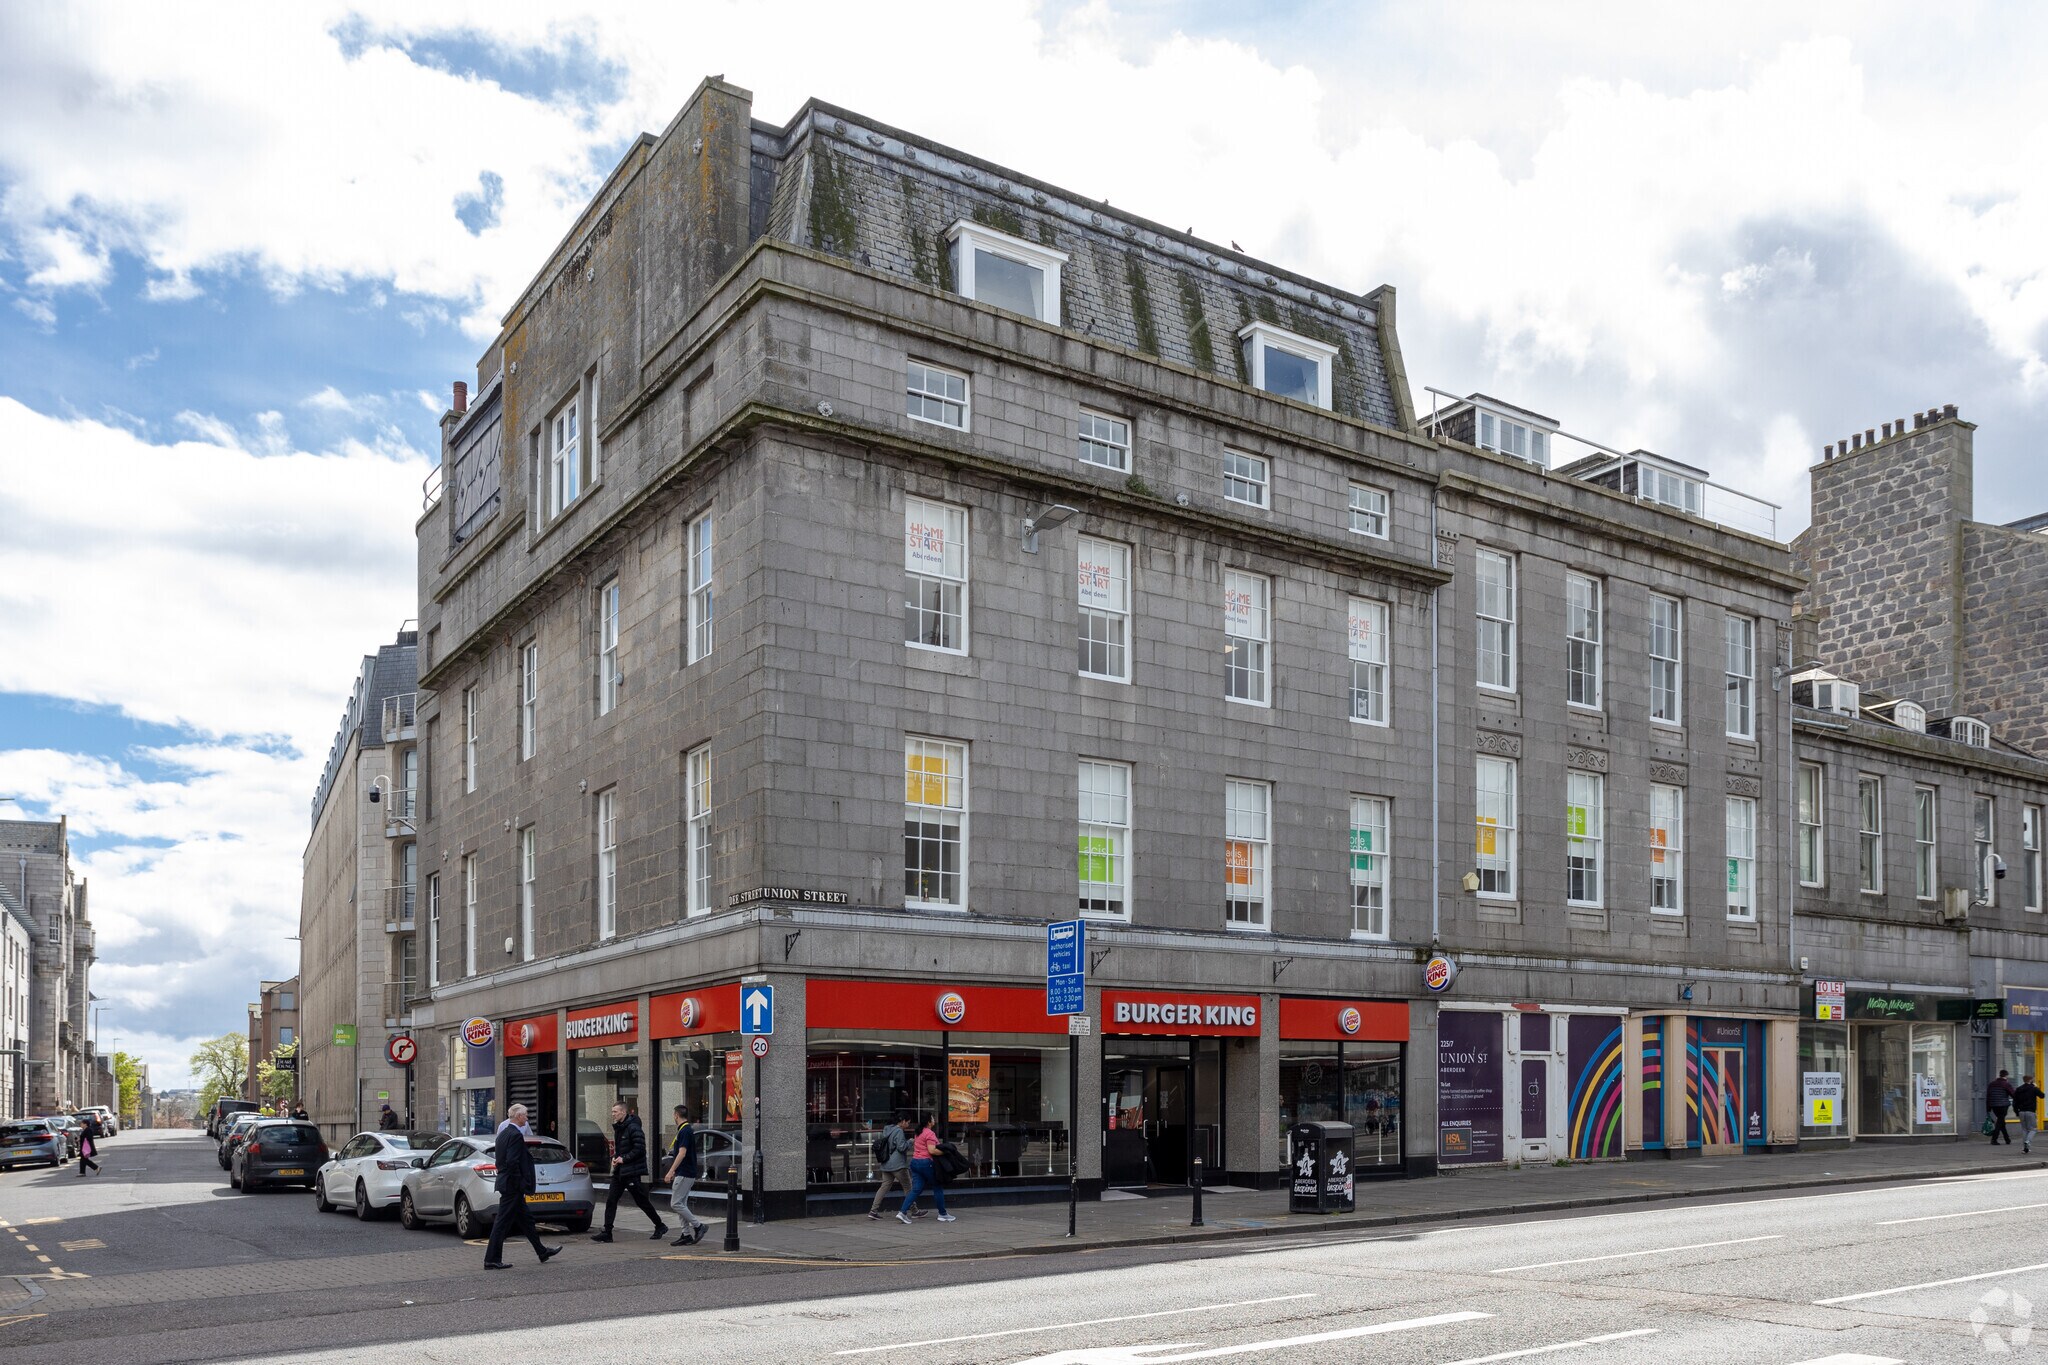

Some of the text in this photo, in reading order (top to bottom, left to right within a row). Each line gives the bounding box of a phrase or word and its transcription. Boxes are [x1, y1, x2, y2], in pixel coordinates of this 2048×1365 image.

[910, 535, 944, 553] START
[912, 552, 942, 563] Aberdeen
[728, 888, 762, 906] DEE STREET
[764, 888, 848, 903] UNION STREET
[1050, 942, 1074, 951] authorised
[1426, 962, 1447, 975] BURGER
[1427, 969, 1447, 983] KING
[1818, 982, 1843, 992] TO LET
[1117, 1002, 1256, 1026] BURGER KING
[2012, 1003, 2030, 1015] mha
[466, 1022, 490, 1034] BURGER
[566, 1012, 628, 1039] BURGER KING
[467, 1028, 491, 1040] KING
[1717, 1027, 1741, 1036] #UnionSt
[754, 1042, 766, 1052] 20
[949, 1059, 980, 1068] KATSU
[1440, 1053, 1474, 1063] UNION
[950, 1068, 979, 1079] CURRY
[1921, 1089, 1930, 1097] PER
[1446, 1134, 1460, 1144] HSA
[1294, 1184, 1317, 1194] inspired
